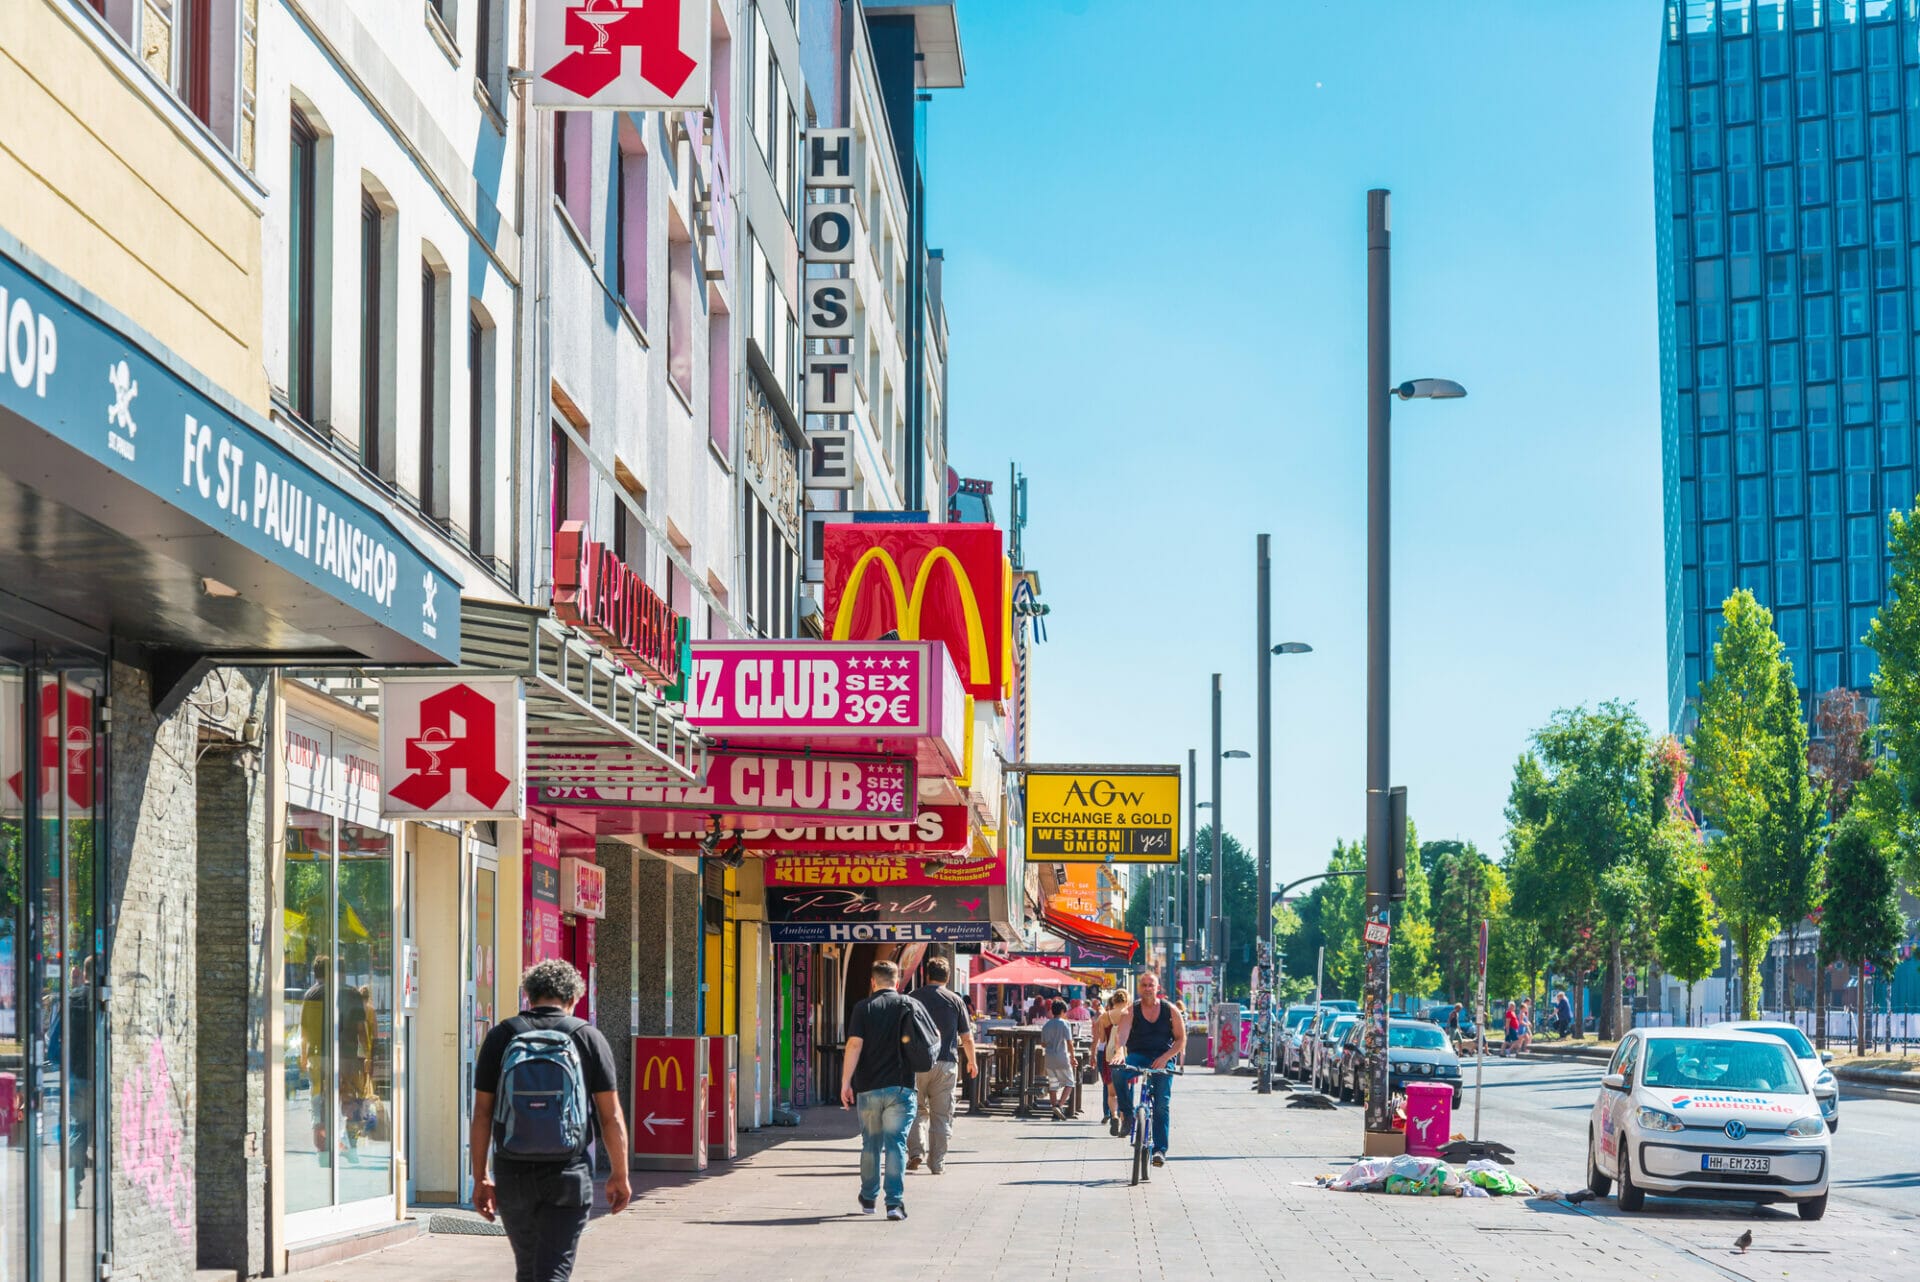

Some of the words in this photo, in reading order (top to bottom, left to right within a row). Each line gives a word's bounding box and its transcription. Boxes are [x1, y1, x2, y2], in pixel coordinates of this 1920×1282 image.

[183, 413, 212, 499] FC
[216, 436, 247, 522] ST.
[253, 461, 312, 559] PAULI
[314, 503, 397, 607] FANSHOP
[735, 659, 840, 719] CLUB
[845, 674, 910, 691] SEX
[844, 694, 911, 723] 39€
[285, 729, 321, 771] UDRUN
[730, 756, 863, 810] CLUB
[866, 776, 904, 789] SEX
[866, 790, 904, 812] 39€
[1032, 811, 1113, 825] EXCHANGE
[1116, 814, 1127, 825] &
[1130, 813, 1173, 826] GOLD
[1037, 829, 1121, 841] WESTERN
[1140, 832, 1168, 853] yes!
[1063, 841, 1121, 853] UNION
[774, 867, 909, 885] KIEZTOUR
[783, 889, 938, 915] Pearls
[779, 924, 825, 936] Ambiente
[829, 923, 933, 941] HOTEL
[1694, 1102, 1794, 1114] mieten.de
[1709, 1157, 1723, 1169] HH
[1729, 1158, 1743, 1170] EM
[1744, 1158, 1769, 1171] 2313
